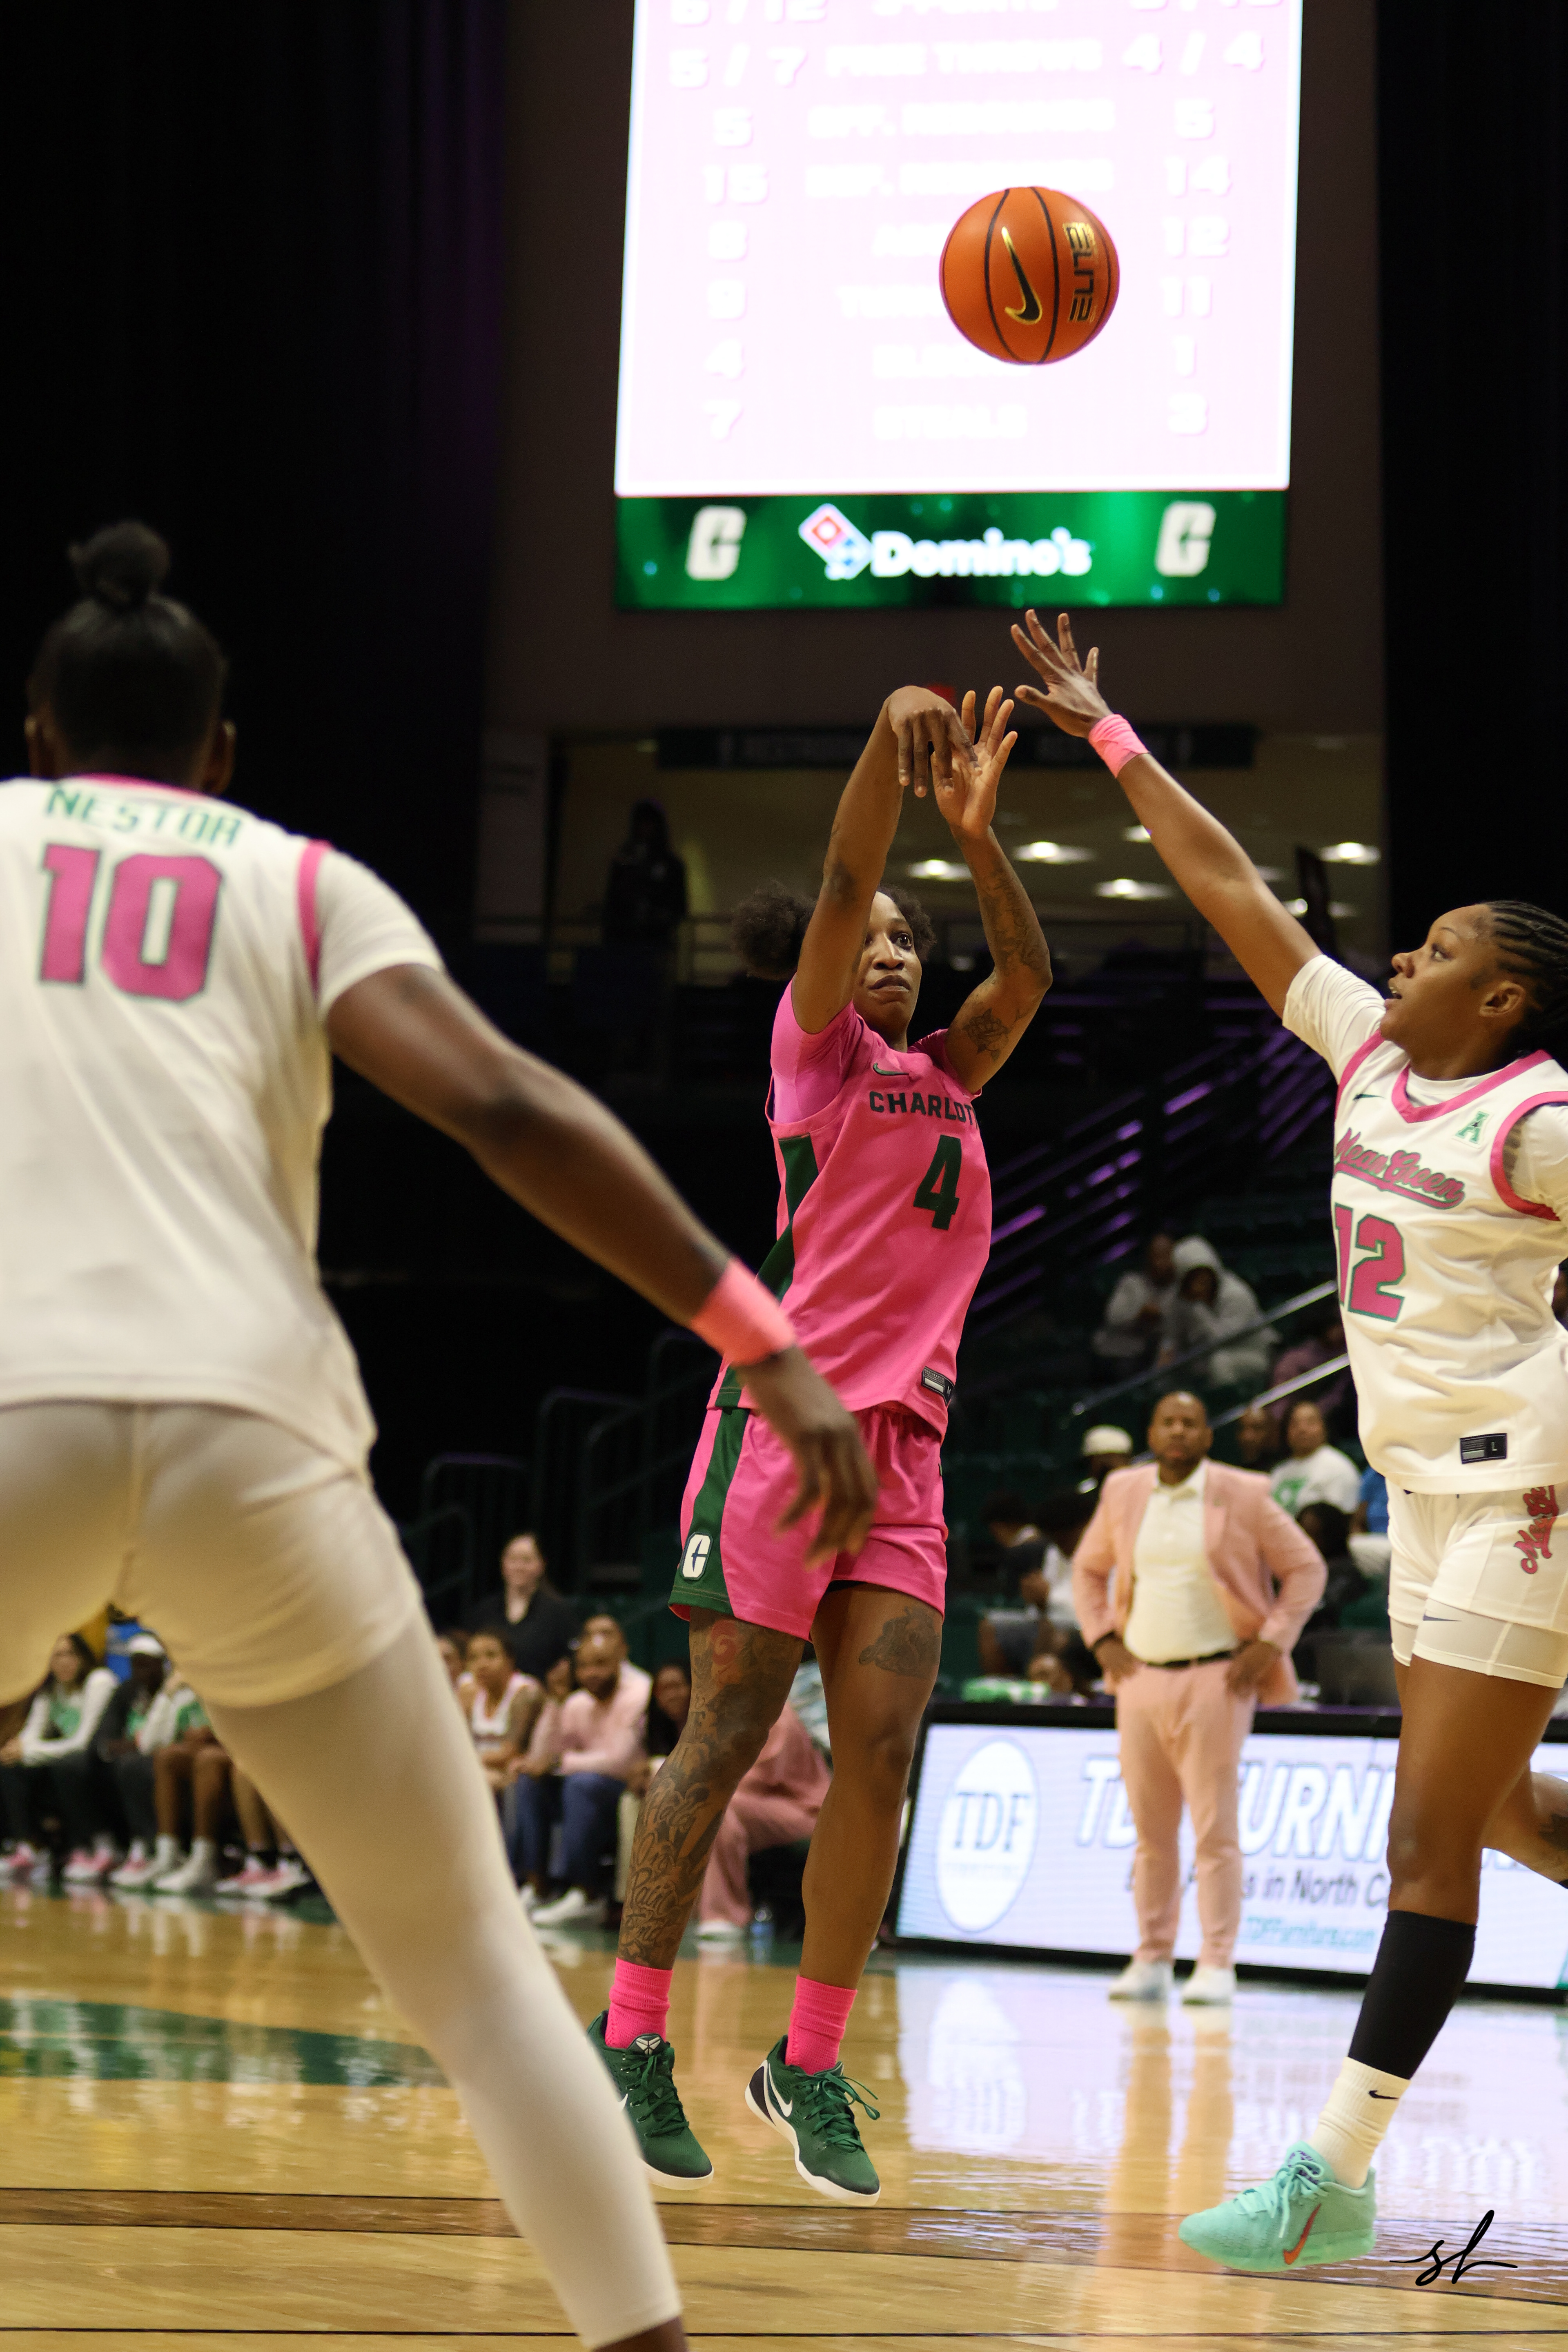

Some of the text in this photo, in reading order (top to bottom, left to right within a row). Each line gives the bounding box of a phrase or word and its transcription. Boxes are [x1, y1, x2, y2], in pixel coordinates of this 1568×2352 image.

[713, 107, 752, 146] 5
[1174, 98, 1214, 139] 5
[1062, 222, 1096, 322] ELITE
[870, 526, 1095, 578] Domino's
[46, 787, 241, 848] NESTOR
[38, 842, 223, 1003] 10
[869, 1091, 978, 1129] CHARLOT
[913, 1134, 962, 1230] 4
[1334, 1202, 1406, 1323] 12
[1491, 1441, 1498, 1452] L
[953, 1789, 1031, 1853] TDF
